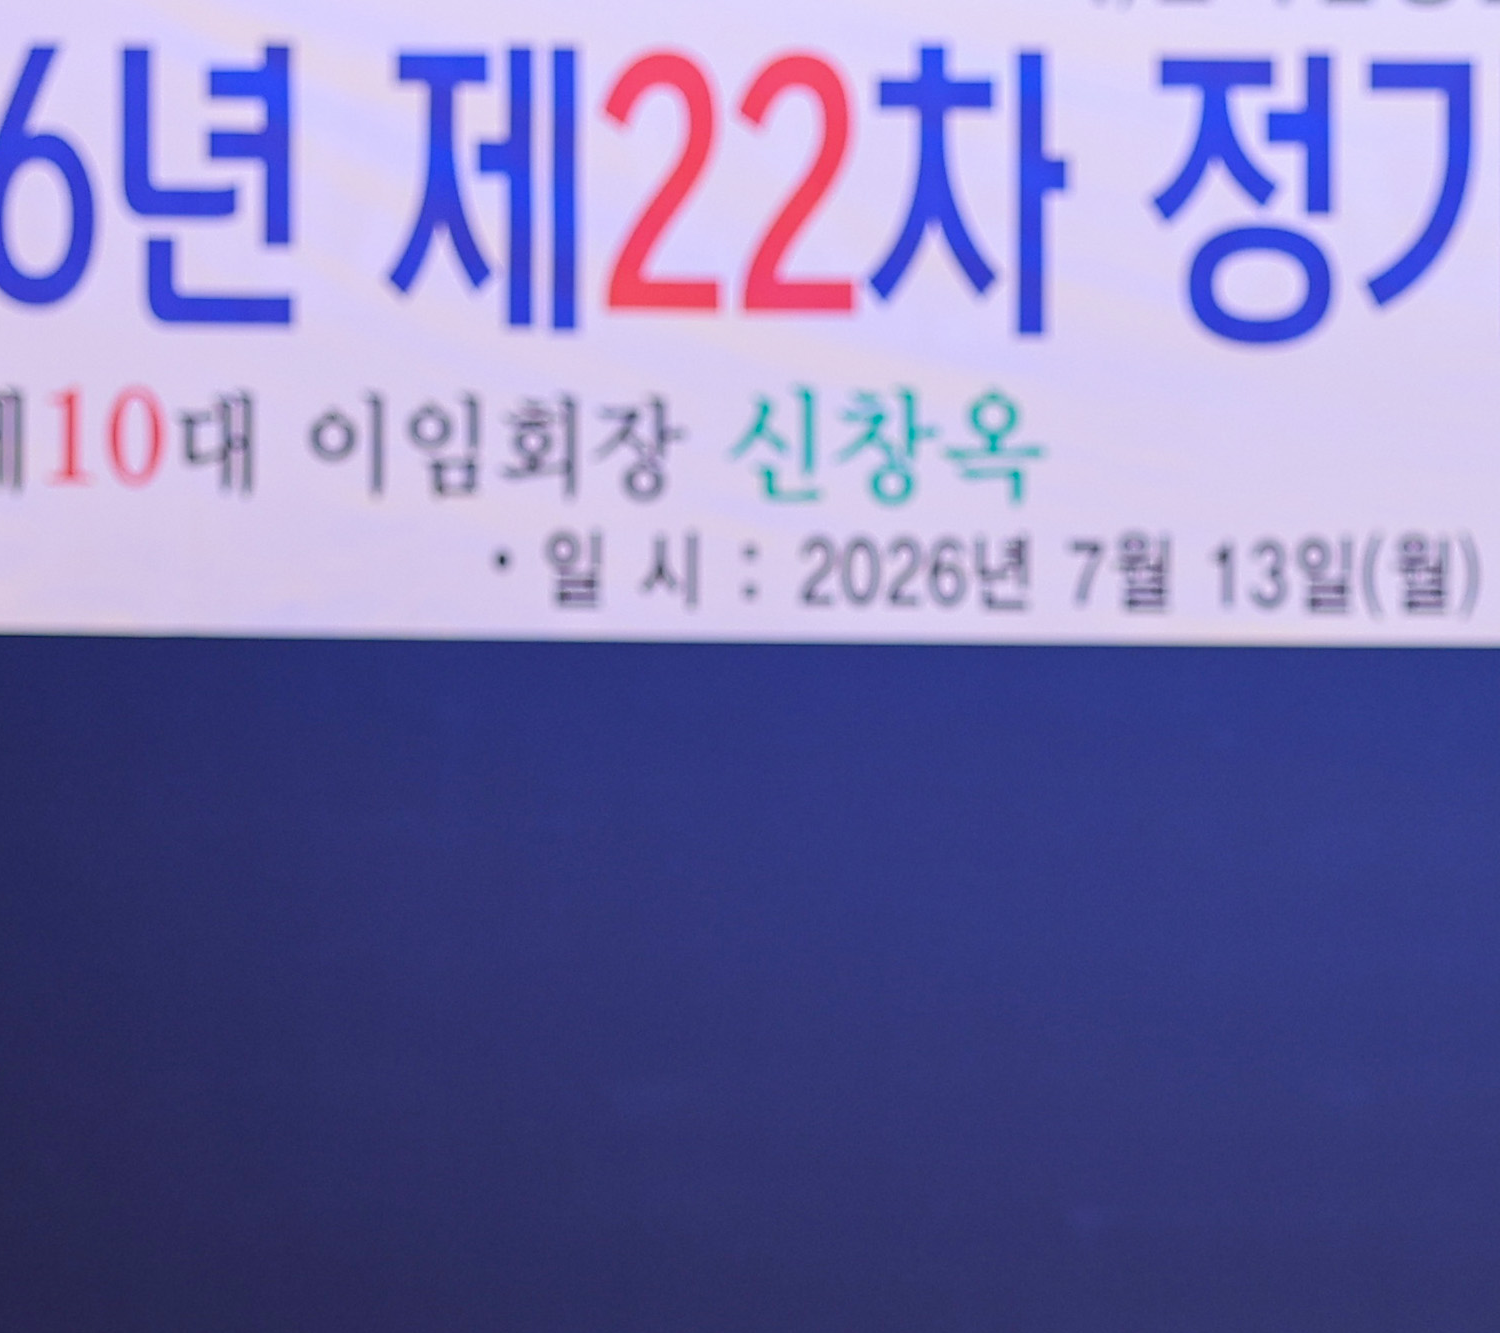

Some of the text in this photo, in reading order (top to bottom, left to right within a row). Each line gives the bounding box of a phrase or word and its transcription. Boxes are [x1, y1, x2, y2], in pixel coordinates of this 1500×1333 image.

[386, 42, 1071, 339] 제22차
[306, 390, 687, 502] 이임회장
[730, 383, 1046, 508] 신창옥
[798, 535, 1030, 612] 2026년
[1068, 535, 1173, 614] 7월
[1210, 537, 1482, 615] 13일(월)
